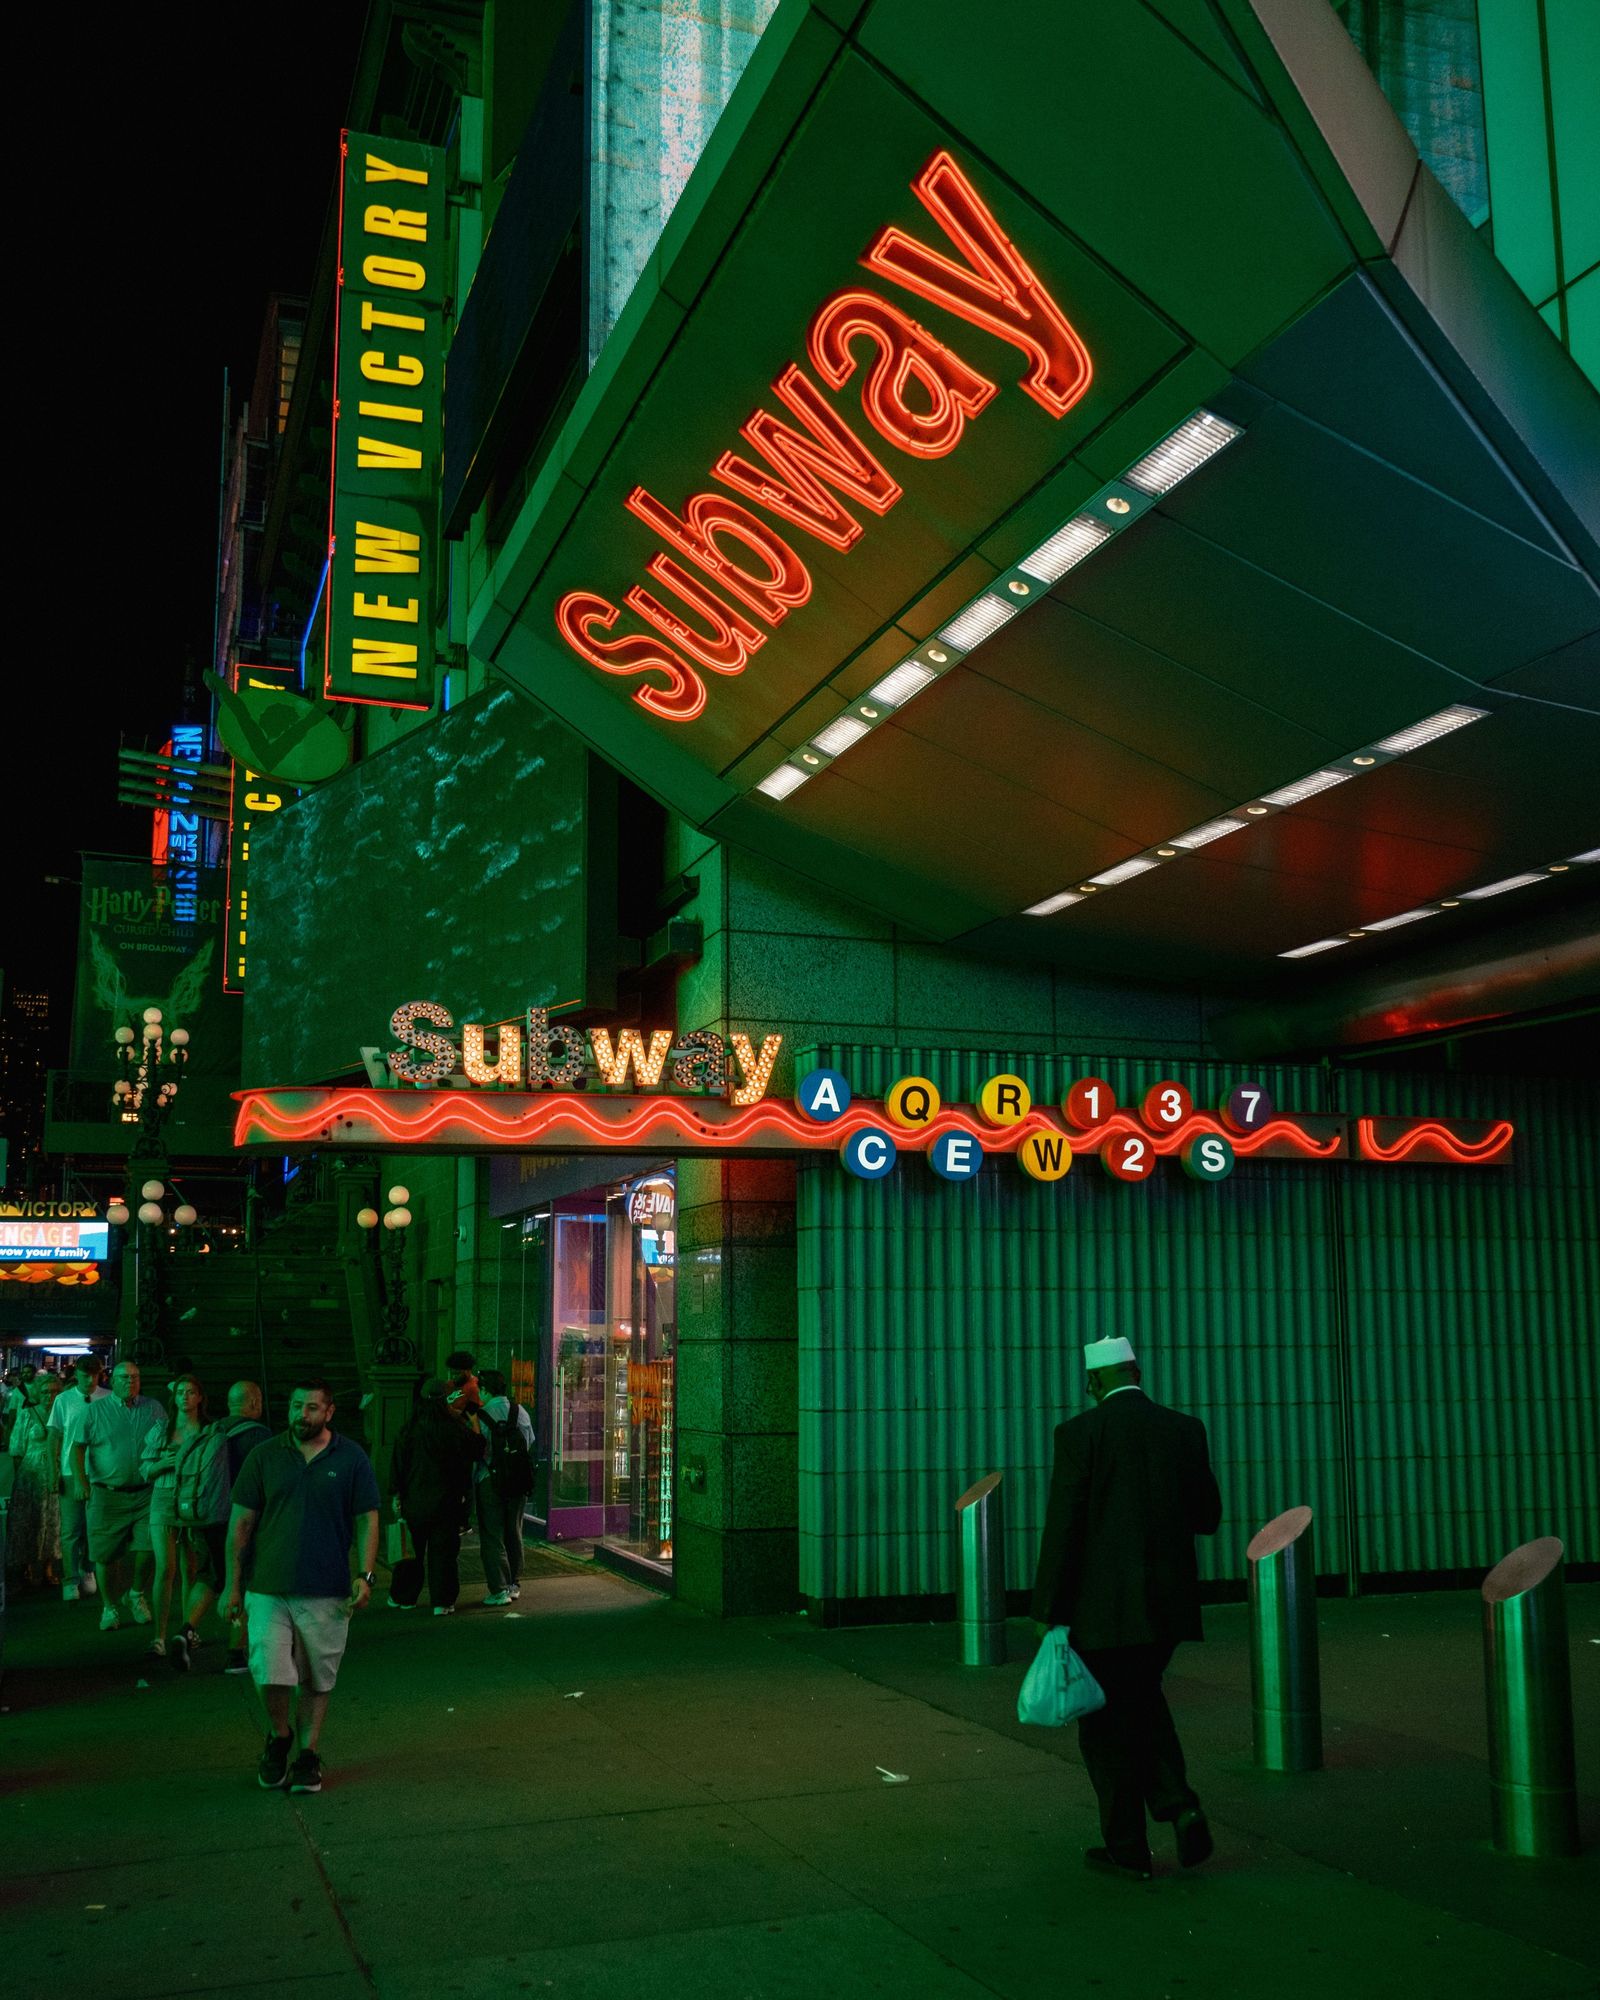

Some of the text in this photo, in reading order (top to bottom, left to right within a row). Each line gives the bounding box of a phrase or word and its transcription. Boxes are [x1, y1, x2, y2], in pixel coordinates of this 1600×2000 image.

[351, 153, 428, 679] NEW VICTORY
[555, 145, 1093, 722] Subway
[87, 886, 153, 925] Harry
[113, 925, 156, 936] CURSED
[119, 942, 187, 953] ON BROADWAY
[387, 1000, 783, 1106] Subway
[810, 1078, 1260, 1122] A Q R 1 3 7
[857, 1135, 1226, 1172] C E W 2 S
[15, 1200, 98, 1218] VICTORY
[26, 1248, 52, 1259] your
[54, 1247, 90, 1260] family
